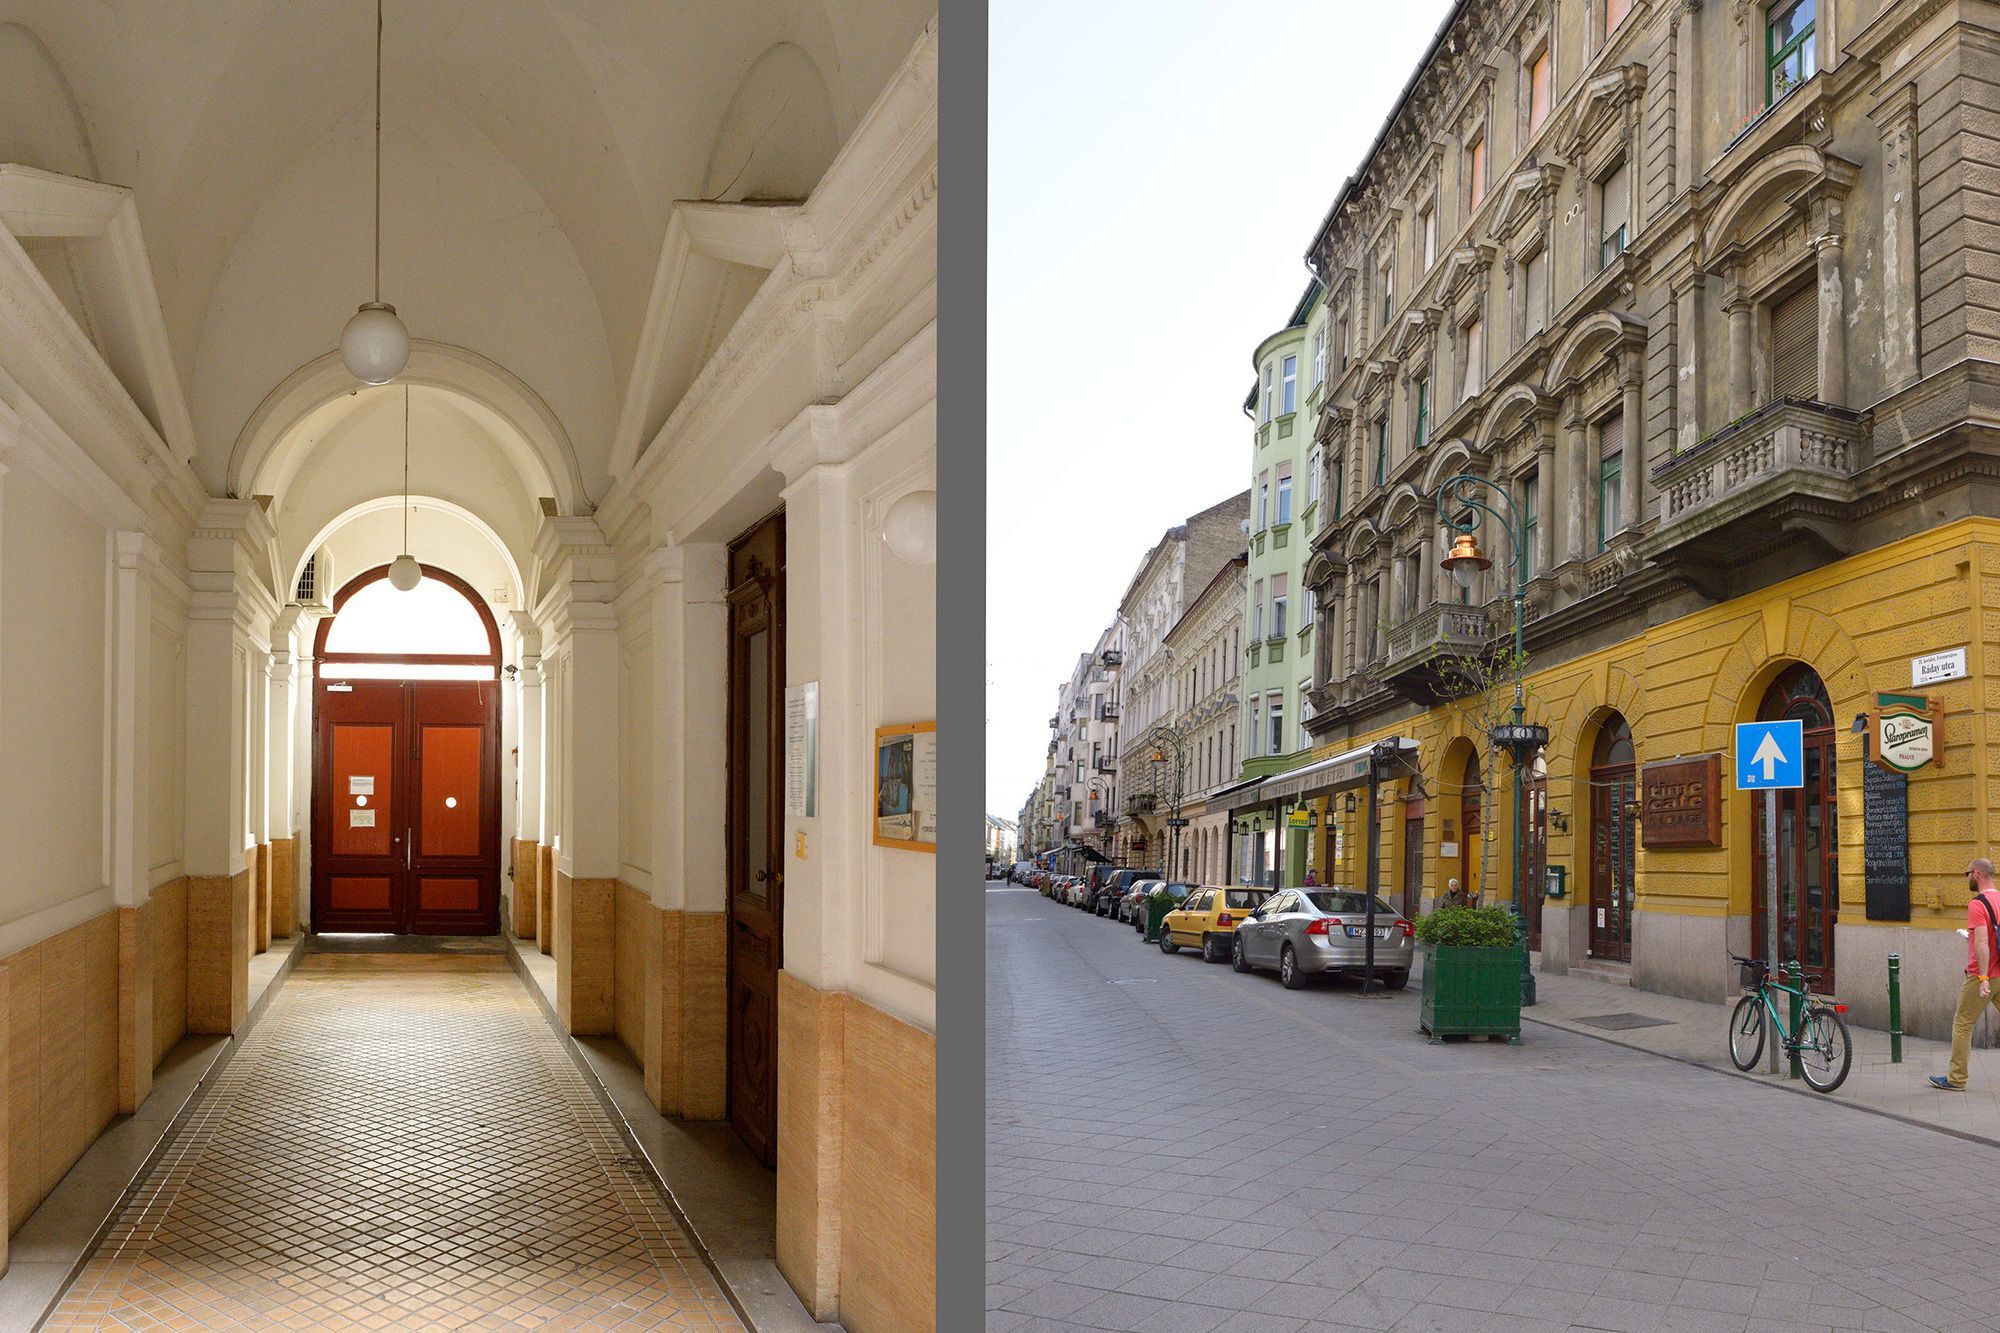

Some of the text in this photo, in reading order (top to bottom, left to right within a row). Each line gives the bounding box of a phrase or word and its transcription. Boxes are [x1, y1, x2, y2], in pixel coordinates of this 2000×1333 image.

[1921, 661, 1955, 675] Ráday utca
[1884, 723, 1929, 745] Staropramen
[1648, 780, 1702, 797] time
[1647, 795, 1702, 810] cafe
[1660, 813, 1702, 825] LOUNGE
